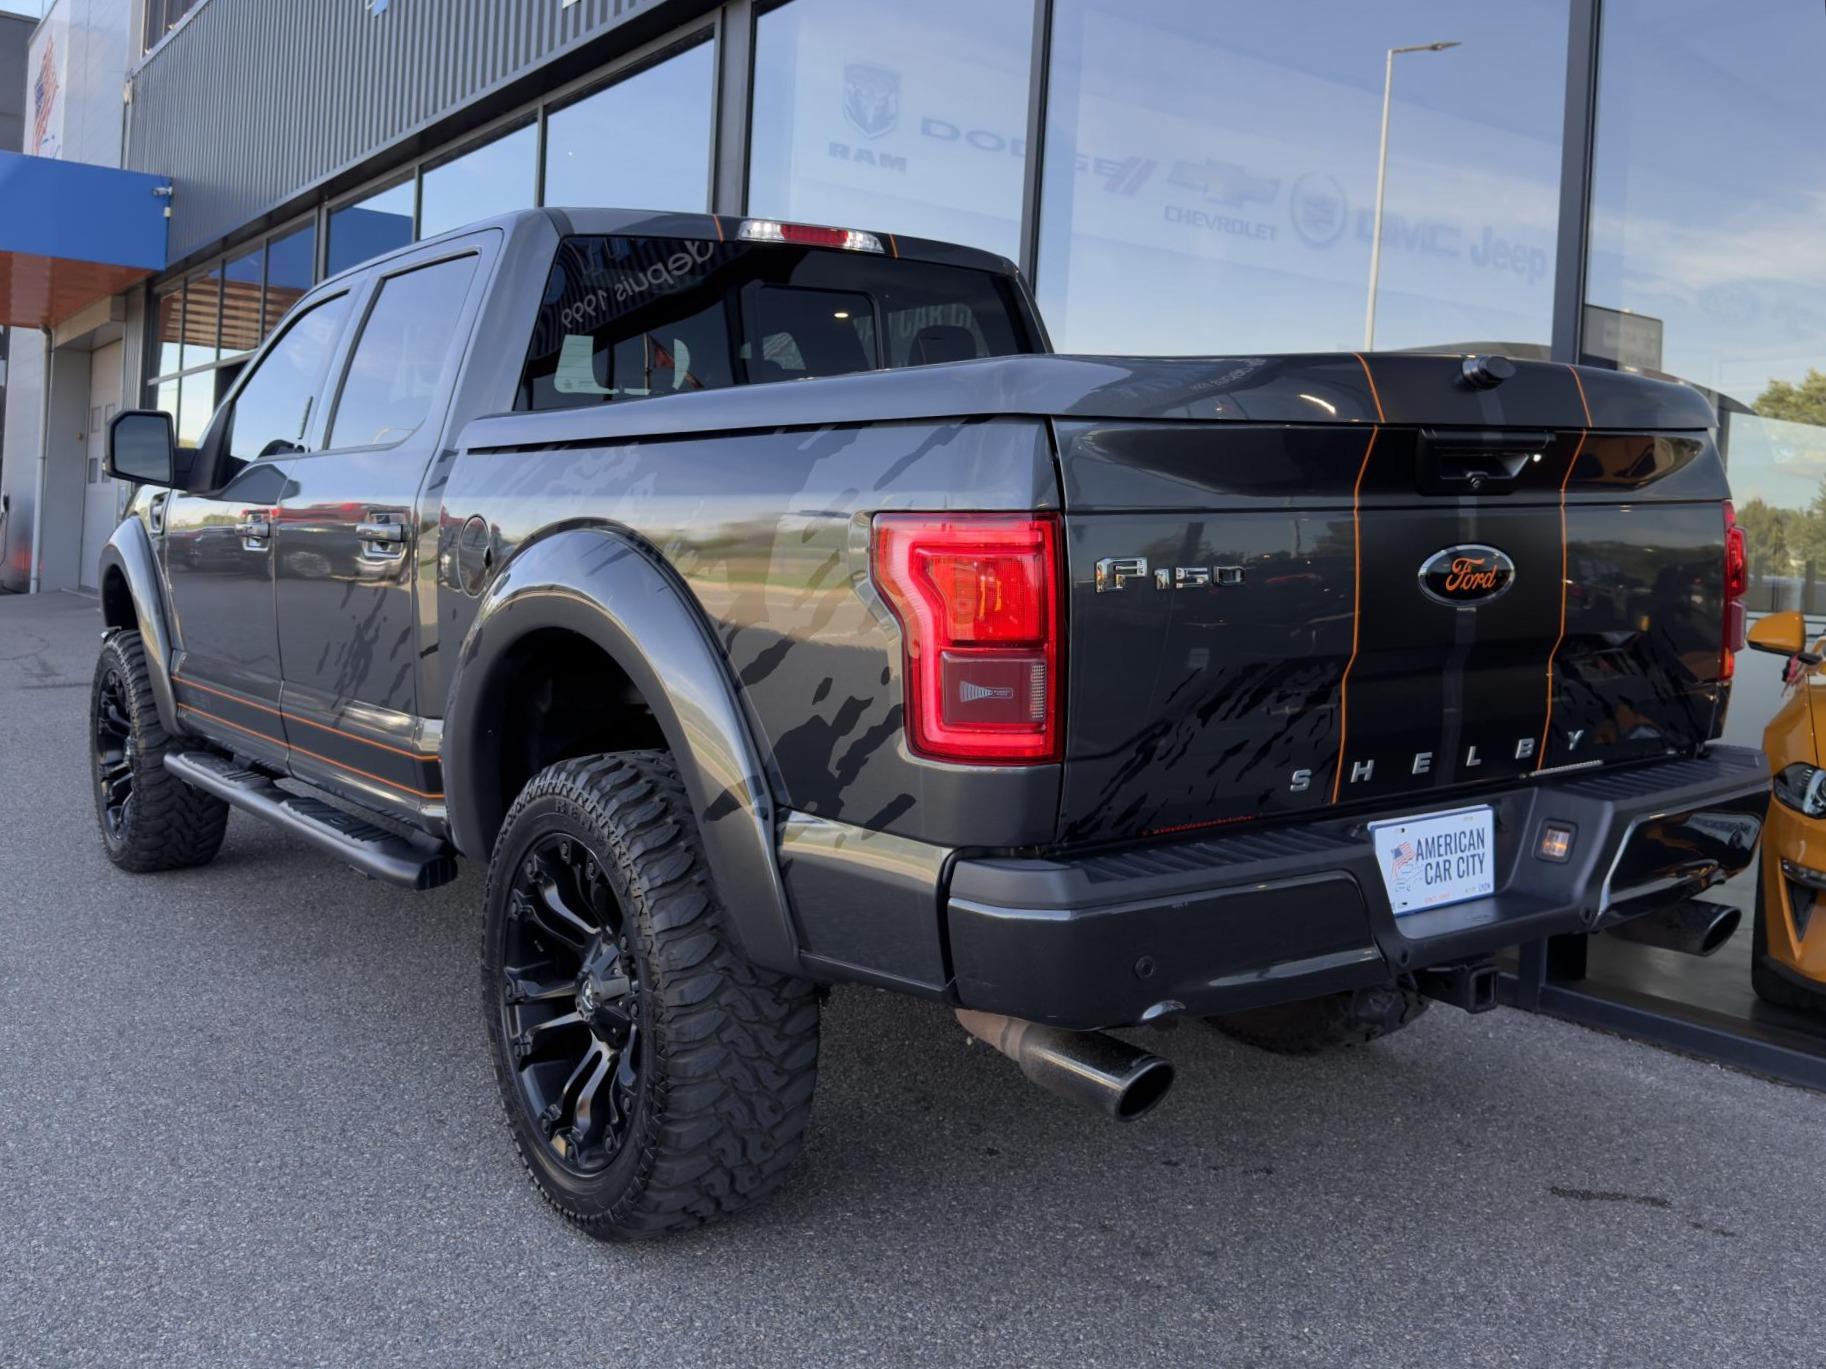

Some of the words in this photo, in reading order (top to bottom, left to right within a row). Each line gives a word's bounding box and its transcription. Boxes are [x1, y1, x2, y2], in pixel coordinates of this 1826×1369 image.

[828, 141, 908, 173] RAM
[1164, 204, 1277, 240] CHEVROLET
[1470, 225, 1545, 285] Jeep
[1446, 557, 1498, 591] Ford
[1290, 729, 1584, 791] SHELBY
[1416, 827, 1485, 862] AMERICAN
[1424, 859, 1453, 885] CAR
[1457, 852, 1485, 879] CITY
